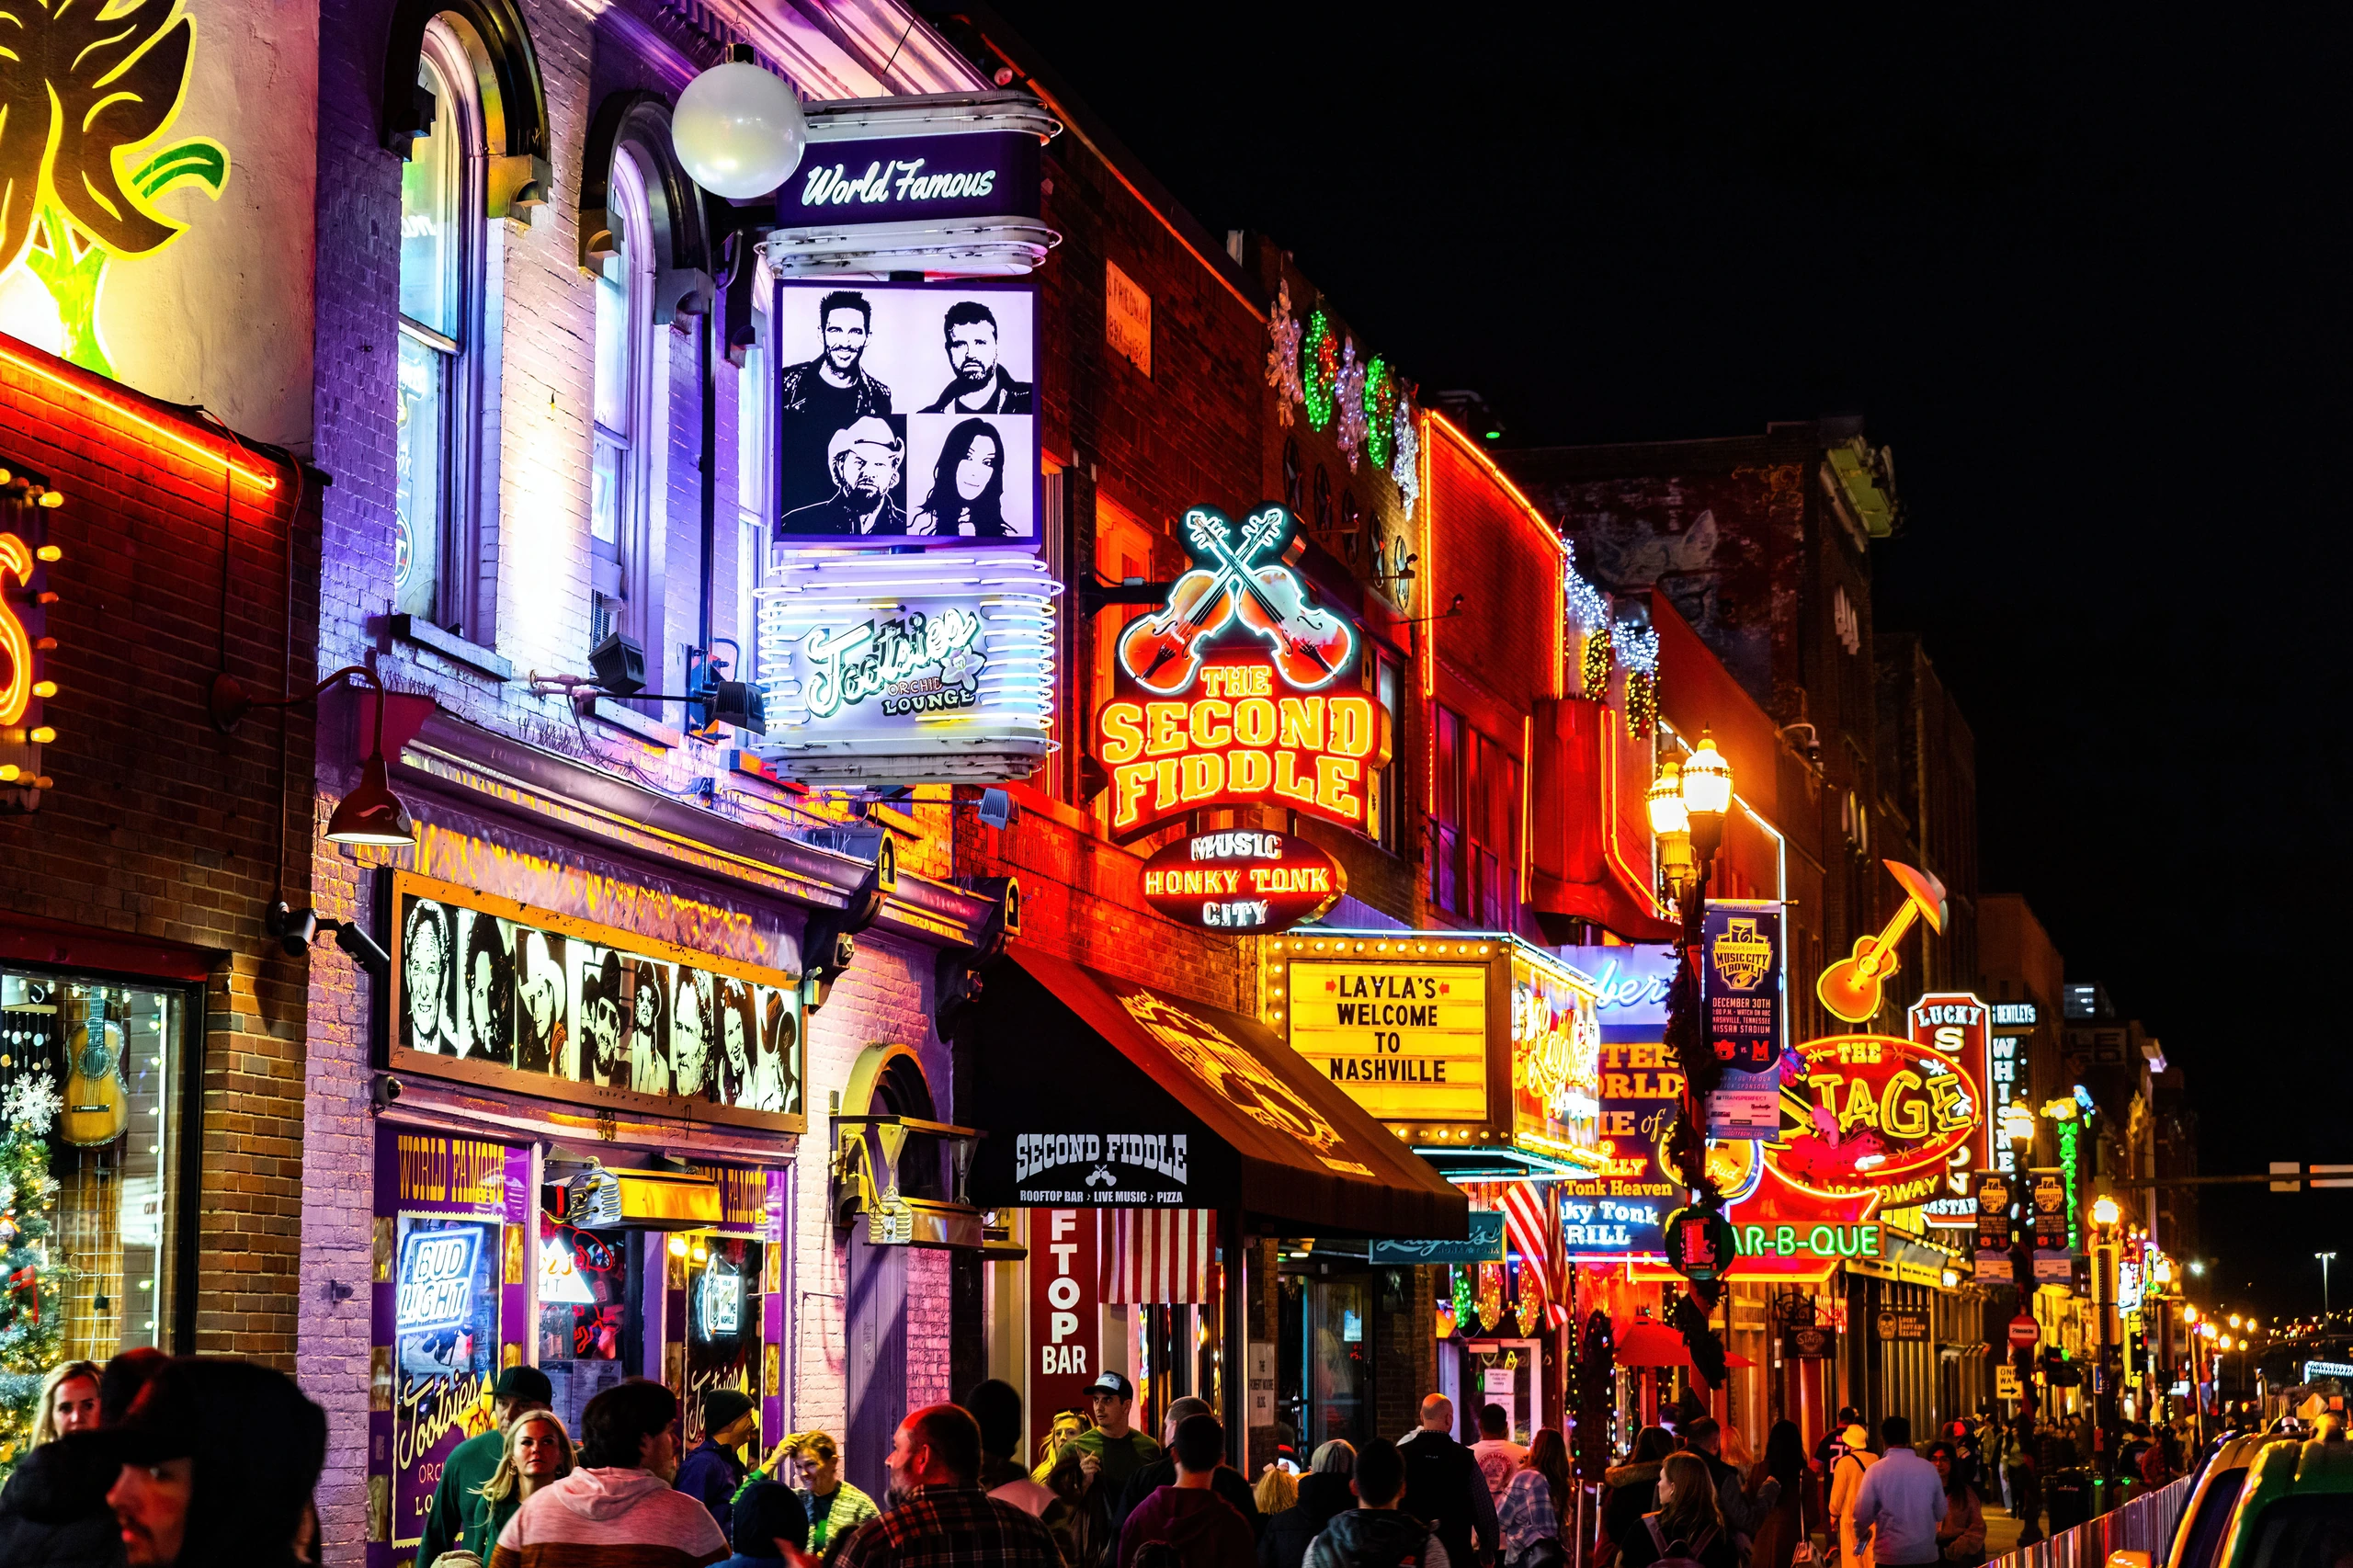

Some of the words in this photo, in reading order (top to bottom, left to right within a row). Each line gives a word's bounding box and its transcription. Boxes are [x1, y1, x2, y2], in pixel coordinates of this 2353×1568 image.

[801, 160, 895, 206] World
[895, 158, 996, 201] Famous
[888, 676, 942, 697] ORCHID
[1200, 665, 1272, 696] THE
[883, 689, 975, 716] LOUNGE
[1101, 697, 1374, 764] SECOND
[1114, 750, 1360, 826] FIDDLE
[1190, 833, 1282, 861] MUSIC
[1144, 869, 1240, 894] HONKY
[1250, 868, 1331, 892] TONK
[1202, 900, 1272, 926] CITY
[1715, 953, 1745, 966] MUSIC
[1746, 953, 1768, 967] CITY
[1728, 963, 1756, 973] BOWL
[1339, 975, 1436, 999] LAYLA'S
[1597, 959, 1671, 1009] ber
[1336, 1004, 1438, 1027] WELCOME
[1712, 997, 1750, 1007] DECEMBER
[1752, 998, 1771, 1008] 30TH
[1712, 1016, 1742, 1024] NASHVILLE,
[1743, 1017, 1770, 1025] TENNESSEE
[1915, 1005, 1982, 1027] LUCKY
[1374, 1032, 1401, 1053] TO
[1712, 1025, 1737, 1033] NISSAN
[1740, 1025, 1770, 1034] STADIUM
[1600, 1042, 1680, 1068] TER
[1836, 1042, 1881, 1063] THE
[1330, 1058, 1446, 1083] NASHVILLE
[1807, 1070, 1972, 1139] TAGE
[1993, 1037, 2017, 1173] WHISKE
[1641, 1108, 1666, 1142] of
[398, 1135, 447, 1201] WORLD
[451, 1139, 506, 1204] FAMOUS
[1017, 1133, 1099, 1184] SECOND
[1107, 1134, 1187, 1185] FIDDLE
[727, 1169, 767, 1224] FAMOUS
[1019, 1190, 1063, 1202] ROOFTOP
[1064, 1191, 1084, 1202] BAR
[1094, 1191, 1113, 1202] LIVE
[1115, 1191, 1146, 1202] MUSIC
[1157, 1191, 1183, 1203] PIZZA
[1564, 1180, 1607, 1196] Tonk
[1609, 1180, 1673, 1196] Heaven
[1560, 1201, 1595, 1223] ky
[1599, 1201, 1660, 1225] Tonk
[1921, 1197, 1978, 1216] ASTA
[1566, 1224, 1631, 1245] RILL
[415, 1239, 467, 1280] BUD
[1048, 1210, 1081, 1344] FTOP
[398, 1277, 469, 1324] LIGHT
[1042, 1345, 1086, 1374] BAR
[399, 1372, 482, 1470] Tootsies
[419, 1462, 444, 1483] ORC
[415, 1494, 434, 1516] LO
